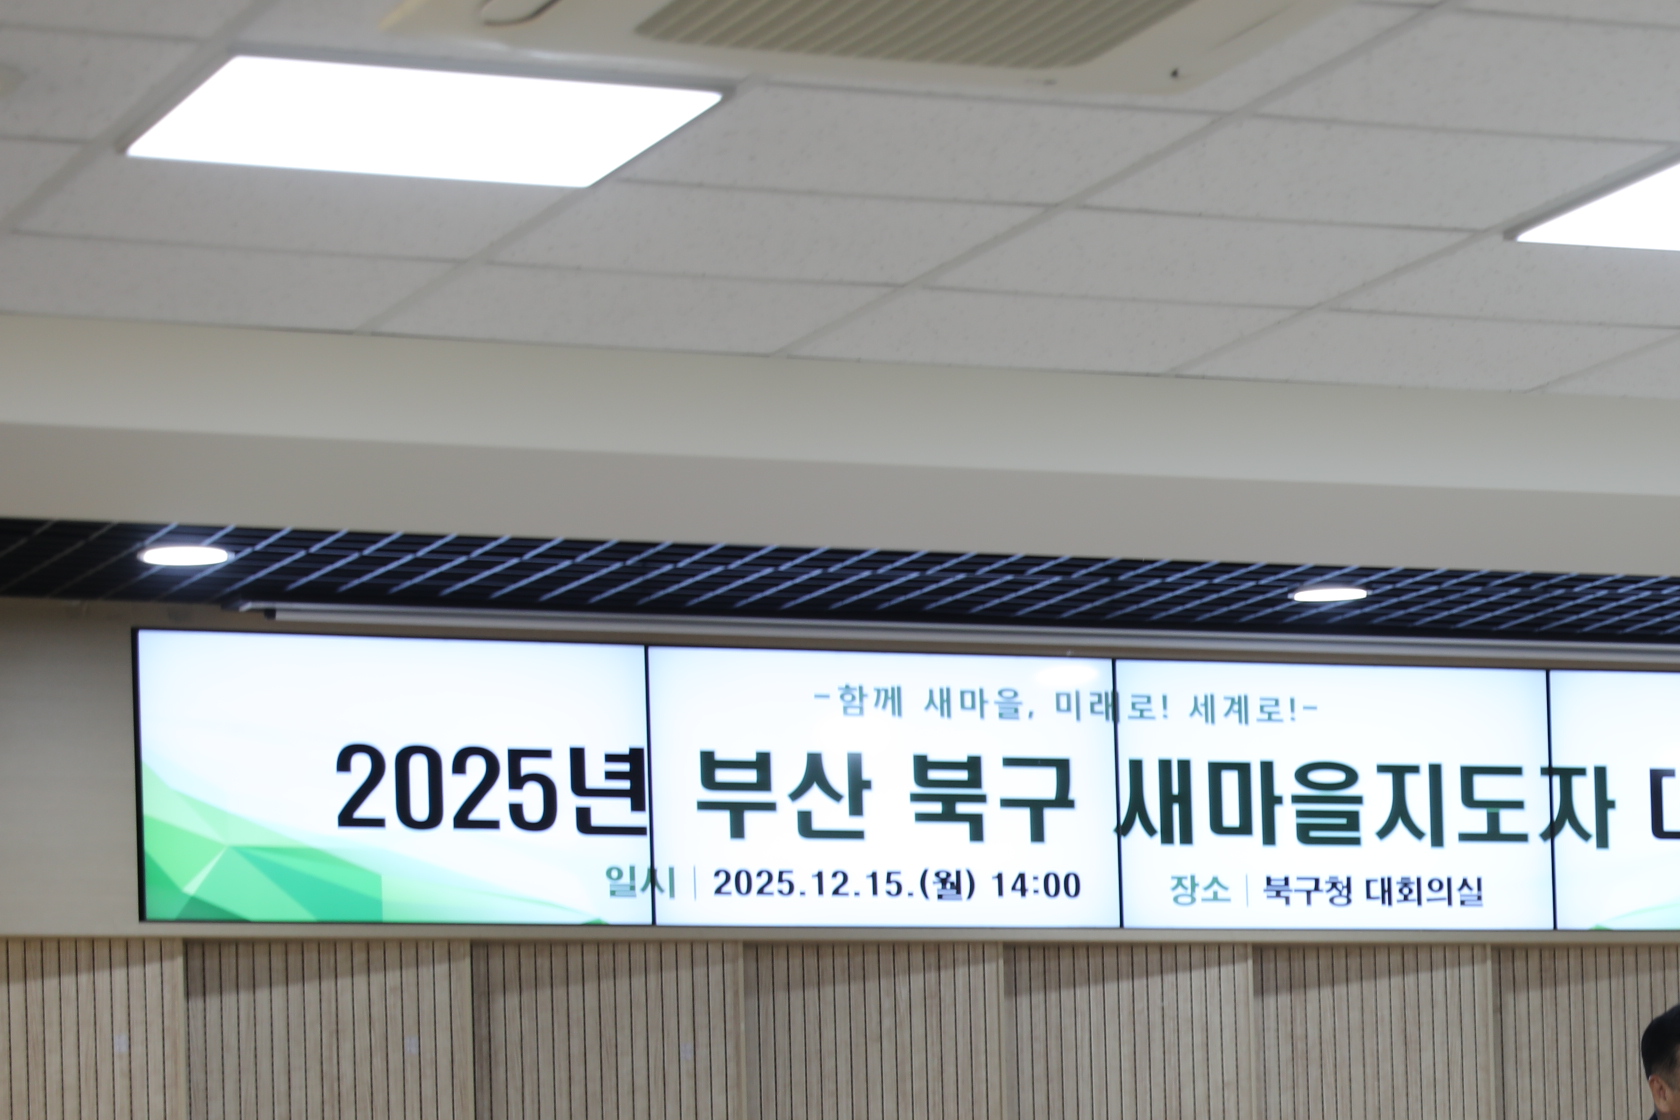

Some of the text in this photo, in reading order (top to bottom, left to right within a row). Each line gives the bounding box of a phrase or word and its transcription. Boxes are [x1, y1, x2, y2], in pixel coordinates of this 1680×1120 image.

[923, 685, 1035, 722] 새마을,
[1055, 688, 1169, 723] 미래로!
[336, 743, 647, 837] 2025년
[697, 750, 872, 841] 부산
[910, 754, 1075, 844] 북구
[1114, 757, 1616, 850] 새마을지도자
[605, 864, 1484, 908] 일시 2025.12.15.(월) 14:00 장소 북구청 대회의실
